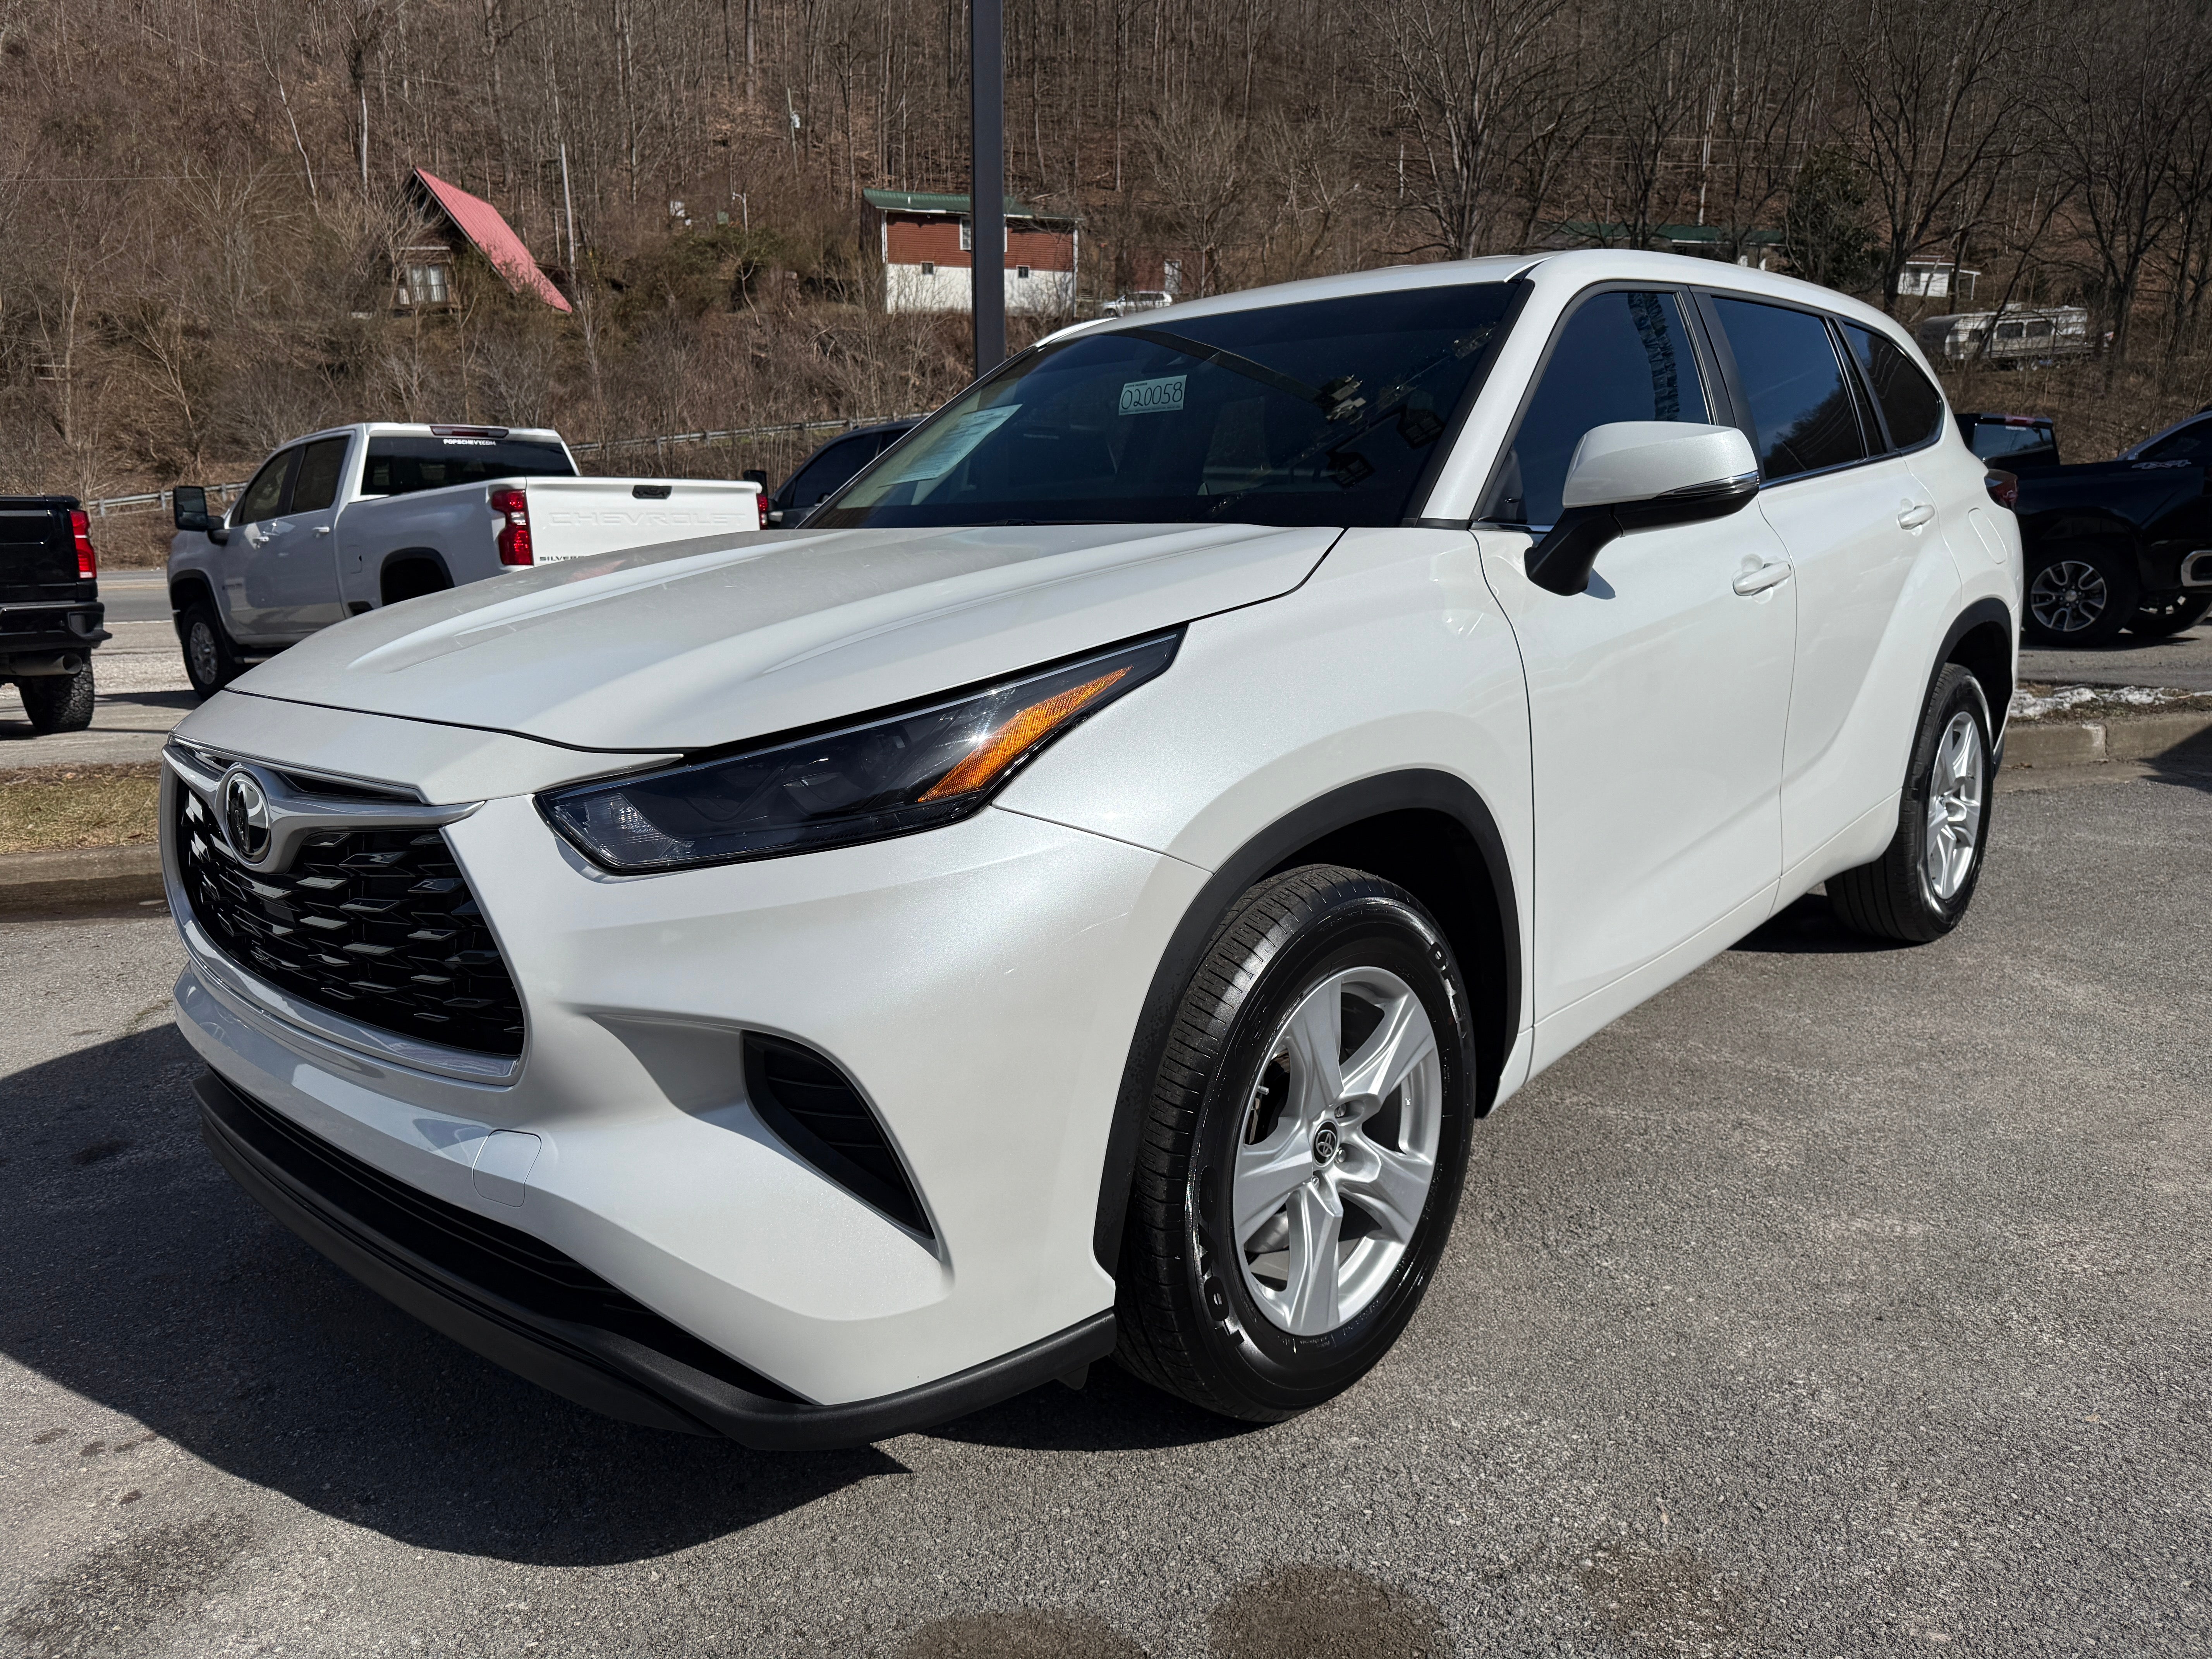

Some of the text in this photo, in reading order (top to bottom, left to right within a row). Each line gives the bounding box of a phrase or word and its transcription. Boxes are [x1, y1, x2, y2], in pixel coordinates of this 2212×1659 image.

[1121, 381, 1183, 410] 020058
[548, 512, 747, 527] CHEVROLET
[1199, 1164, 1245, 1350] TOYO
